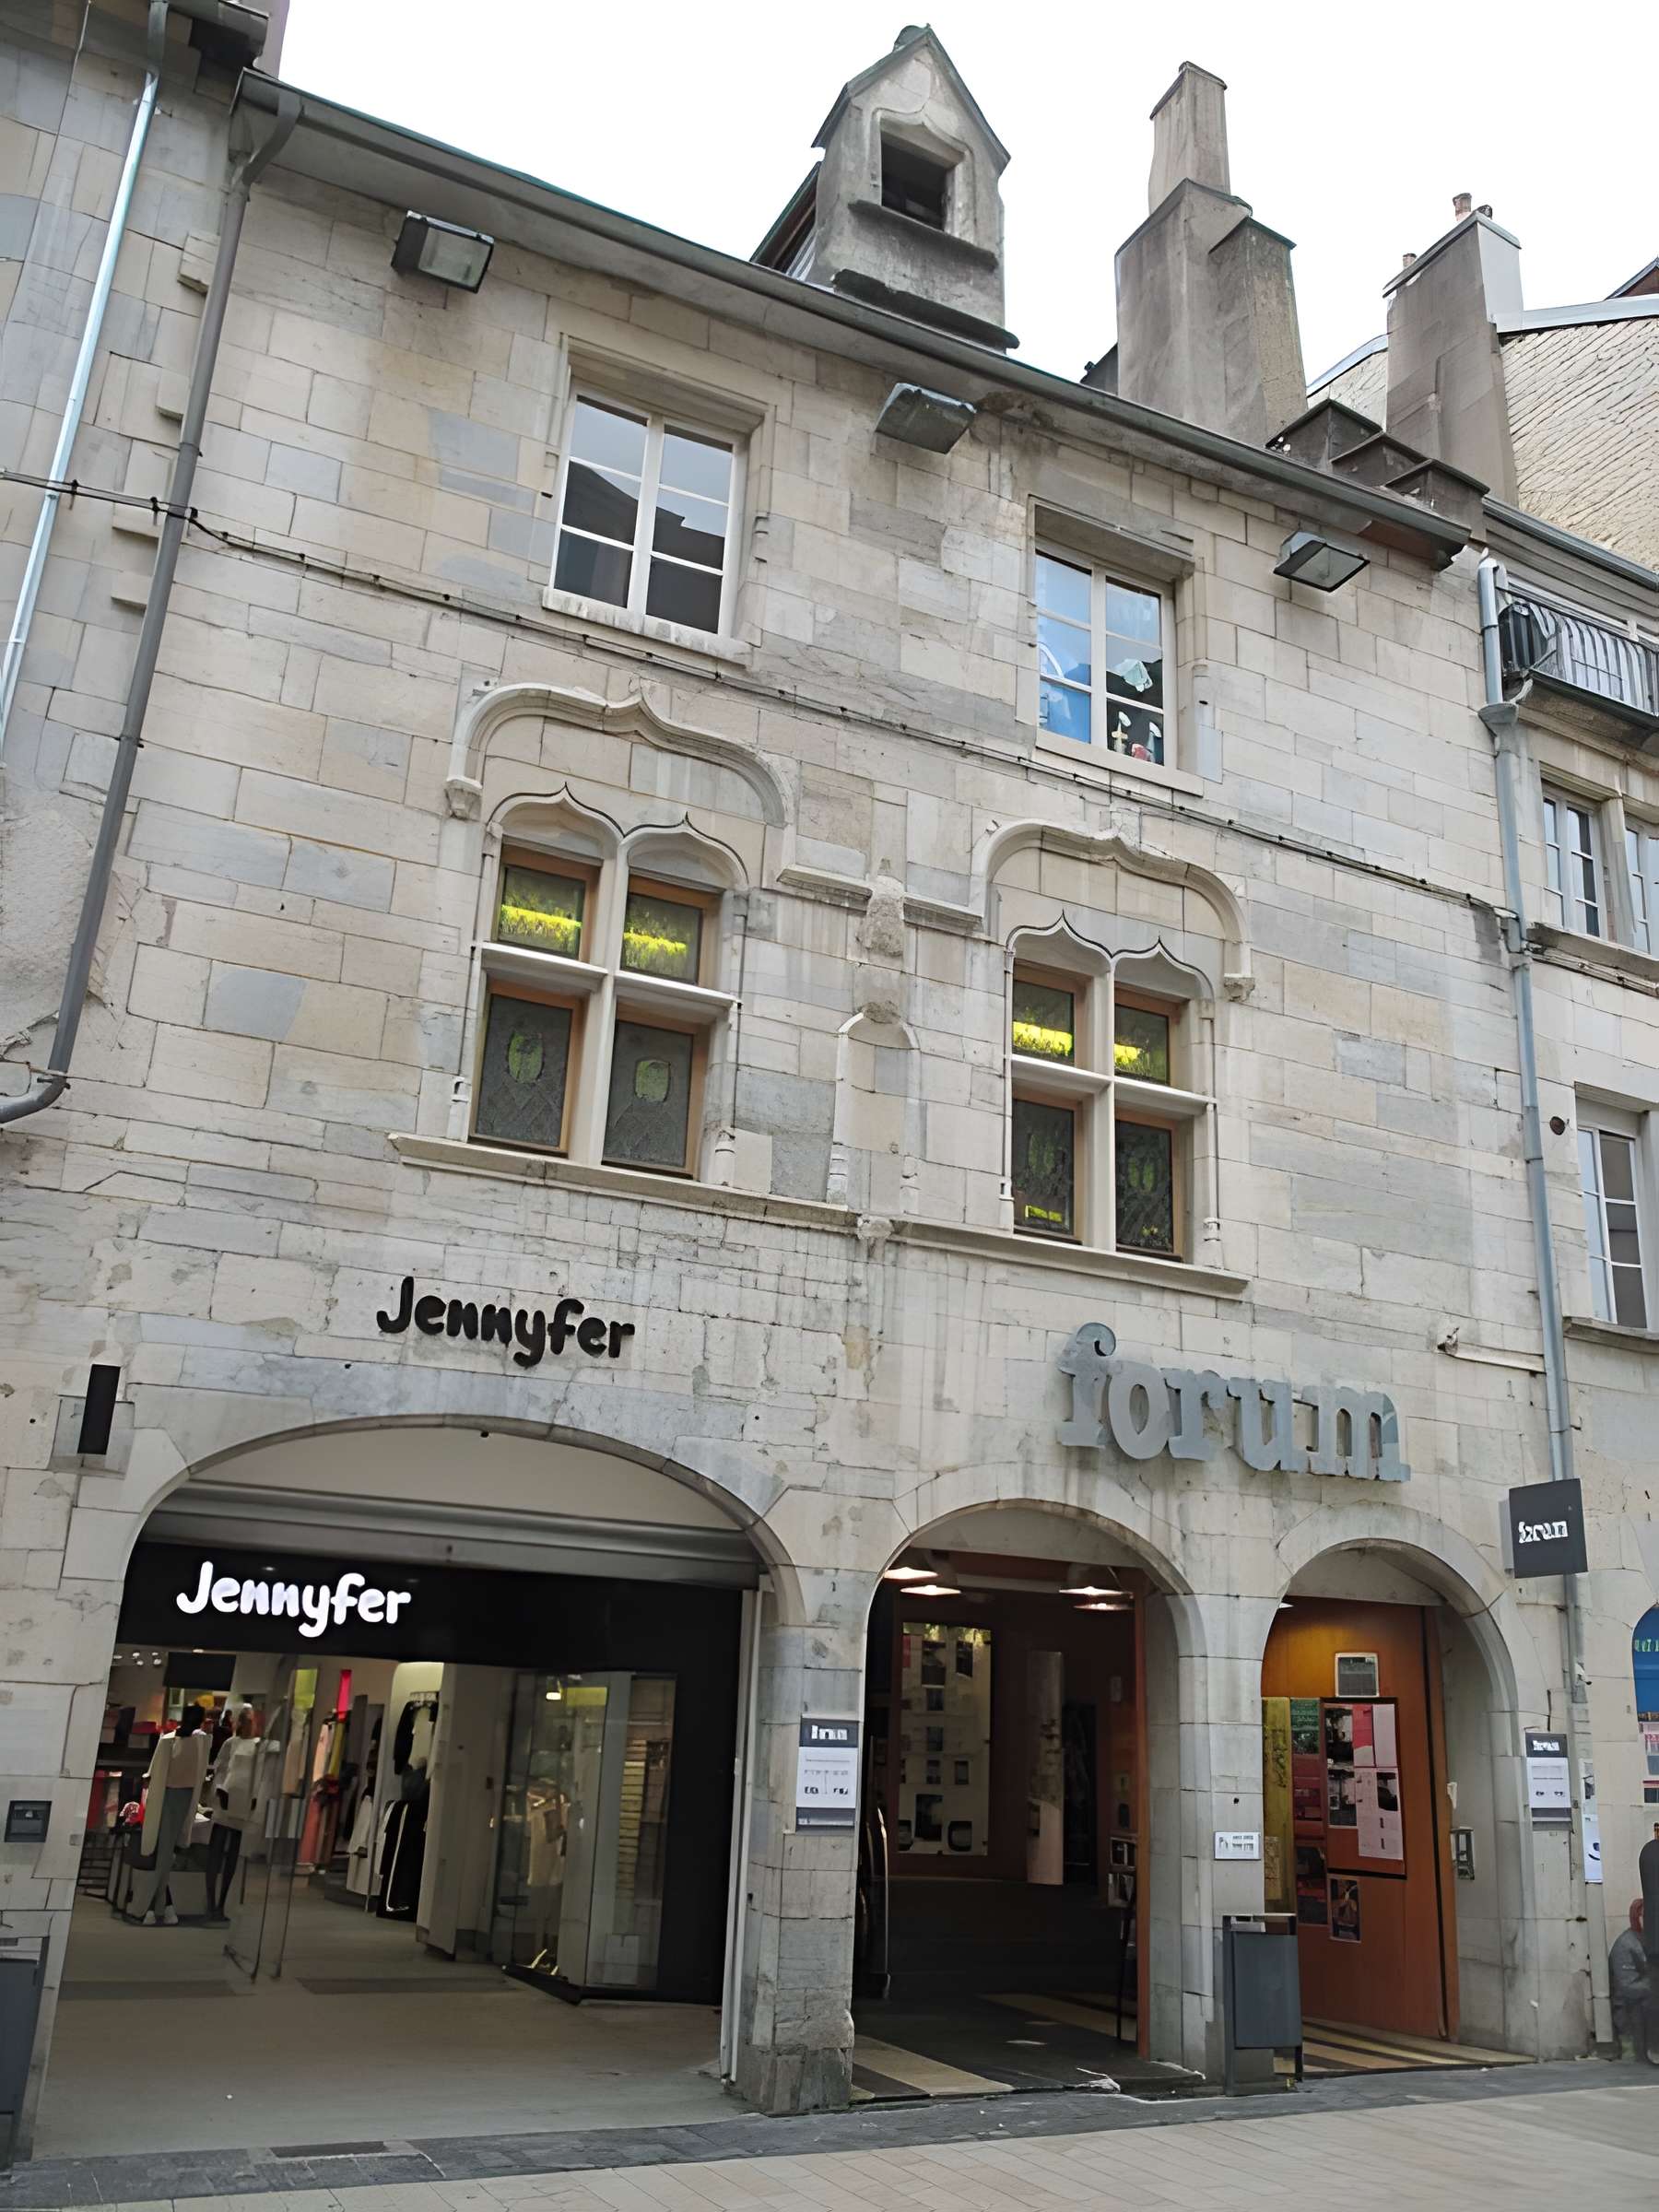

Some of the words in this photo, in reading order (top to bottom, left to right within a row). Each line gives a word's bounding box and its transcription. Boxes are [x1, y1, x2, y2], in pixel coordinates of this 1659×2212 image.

[376, 1276, 635, 1368] Jennyfer
[1056, 1322, 1411, 1483] forum
[176, 1560, 412, 1638] Jennyfer
